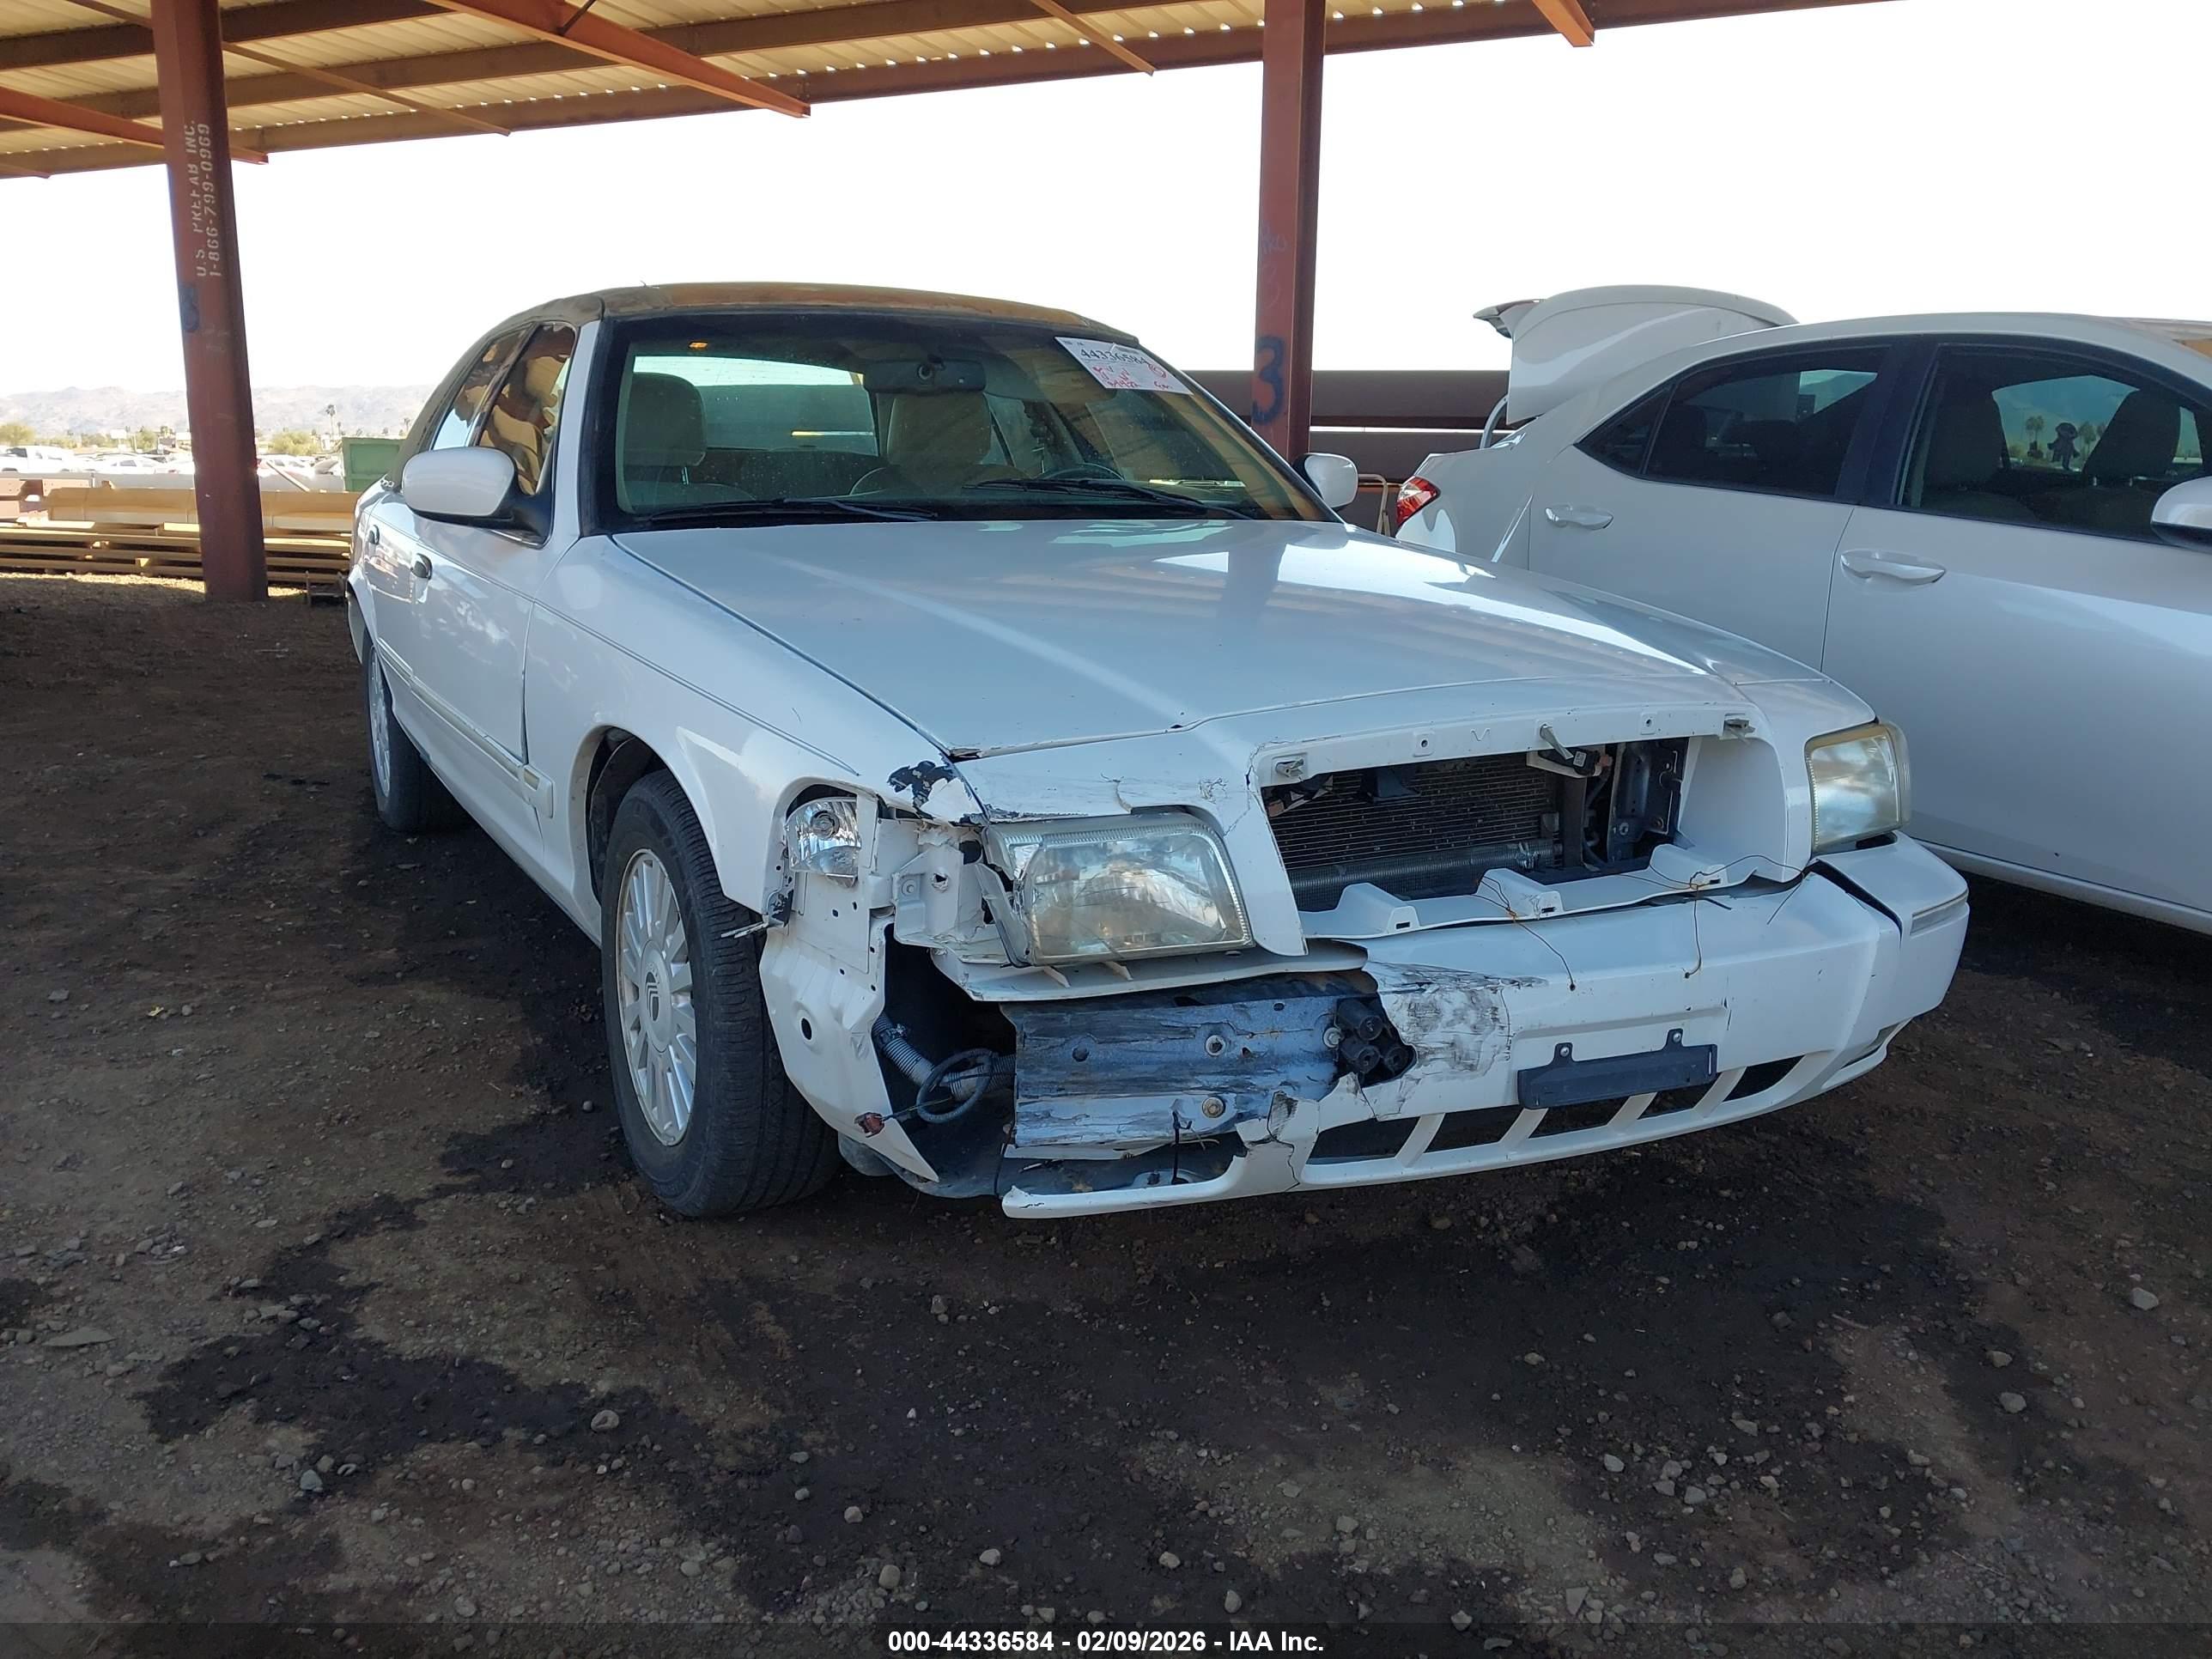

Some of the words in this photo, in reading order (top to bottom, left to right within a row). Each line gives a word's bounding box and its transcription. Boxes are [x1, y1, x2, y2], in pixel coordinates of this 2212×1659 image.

[183, 119, 198, 153] INC.
[186, 163, 204, 233] PREFAB
[198, 123, 222, 276] 1-866-799-0969
[1252, 336, 1285, 426] 3
